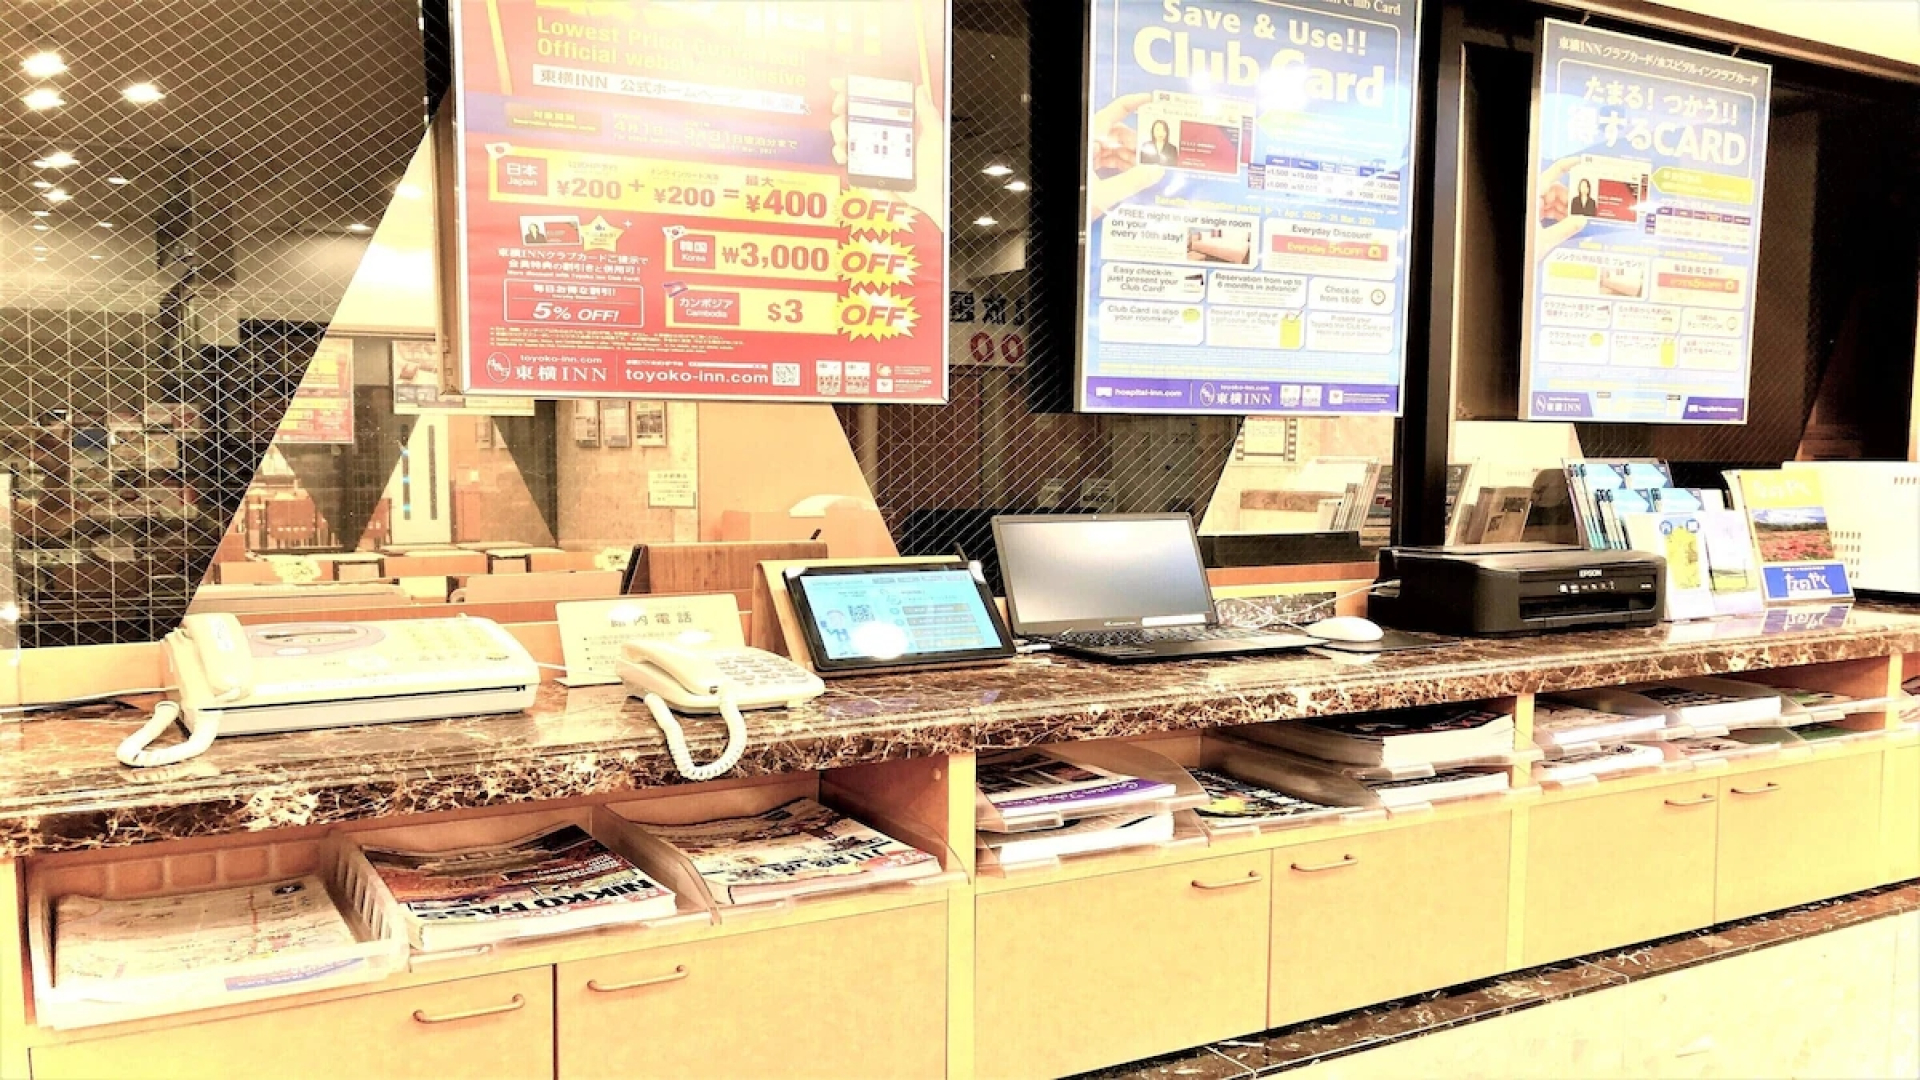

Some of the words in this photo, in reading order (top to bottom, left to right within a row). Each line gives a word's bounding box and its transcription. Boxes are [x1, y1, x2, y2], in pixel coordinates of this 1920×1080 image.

[1374, 1, 1401, 16] Card
[537, 16, 619, 43] Lowest
[1163, 0, 1241, 34] Save
[1254, 14, 1276, 41] &
[1288, 19, 1367, 56] Use!!
[537, 38, 617, 65] Official
[1133, 25, 1260, 88] Club
[1270, 48, 1386, 107] Card
[540, 69, 609, 89] 東横INN
[1584, 75, 1655, 111] たまる!
[1663, 94, 1739, 126] つかう!!
[506, 162, 537, 177] 日本
[506, 176, 538, 188] Japan
[745, 174, 775, 188] 最大
[556, 179, 621, 201] ¥200
[653, 185, 716, 208] ¥200
[745, 189, 828, 219] ¥400
[841, 199, 906, 222] OFF
[1111, 219, 1124, 228] on
[1126, 220, 1148, 230] your
[1118, 208, 1144, 219] FREE
[1147, 211, 1171, 222] night
[1184, 215, 1199, 224] our
[1201, 216, 1228, 228] single
[1228, 220, 1252, 228] room
[1110, 230, 1138, 240] every
[1140, 230, 1161, 239] 10th
[1162, 232, 1184, 243] stay!
[1292, 224, 1331, 238] Everyday
[1287, 241, 1325, 254] Everyday
[681, 252, 706, 263] Korea
[722, 241, 830, 272] ₩3,000
[841, 252, 906, 274] OFF
[1113, 266, 1136, 277] Easy
[1136, 267, 1173, 277] check-in
[1106, 275, 1124, 284] just
[1126, 276, 1158, 285] present
[1160, 278, 1179, 287] your
[1119, 283, 1140, 292] Club
[1215, 273, 1262, 284] Reservation
[1264, 276, 1281, 285] from
[1282, 278, 1293, 288] up
[1294, 279, 1303, 287] to
[1224, 282, 1253, 291] months
[1324, 285, 1359, 295] Check-in
[679, 297, 734, 310] カンボジア
[1319, 294, 1339, 303] from
[533, 302, 572, 321] 5%
[577, 308, 620, 323] OFF!
[685, 309, 729, 319] Cambodia
[767, 299, 804, 323] $3
[841, 305, 906, 326] OFF
[1107, 305, 1128, 313] Club
[1130, 306, 1150, 314] Card
[1114, 314, 1134, 322] your
[520, 355, 603, 365] toyoko-inn.com
[515, 364, 608, 382] 東横INN
[625, 367, 769, 385] toyoko-inn.com
[1114, 388, 1183, 397] hospital-inn.com
[1216, 391, 1272, 405] 東横INN
[1579, 569, 1603, 579] EPSON
[534, 878, 654, 910] NIKKO
